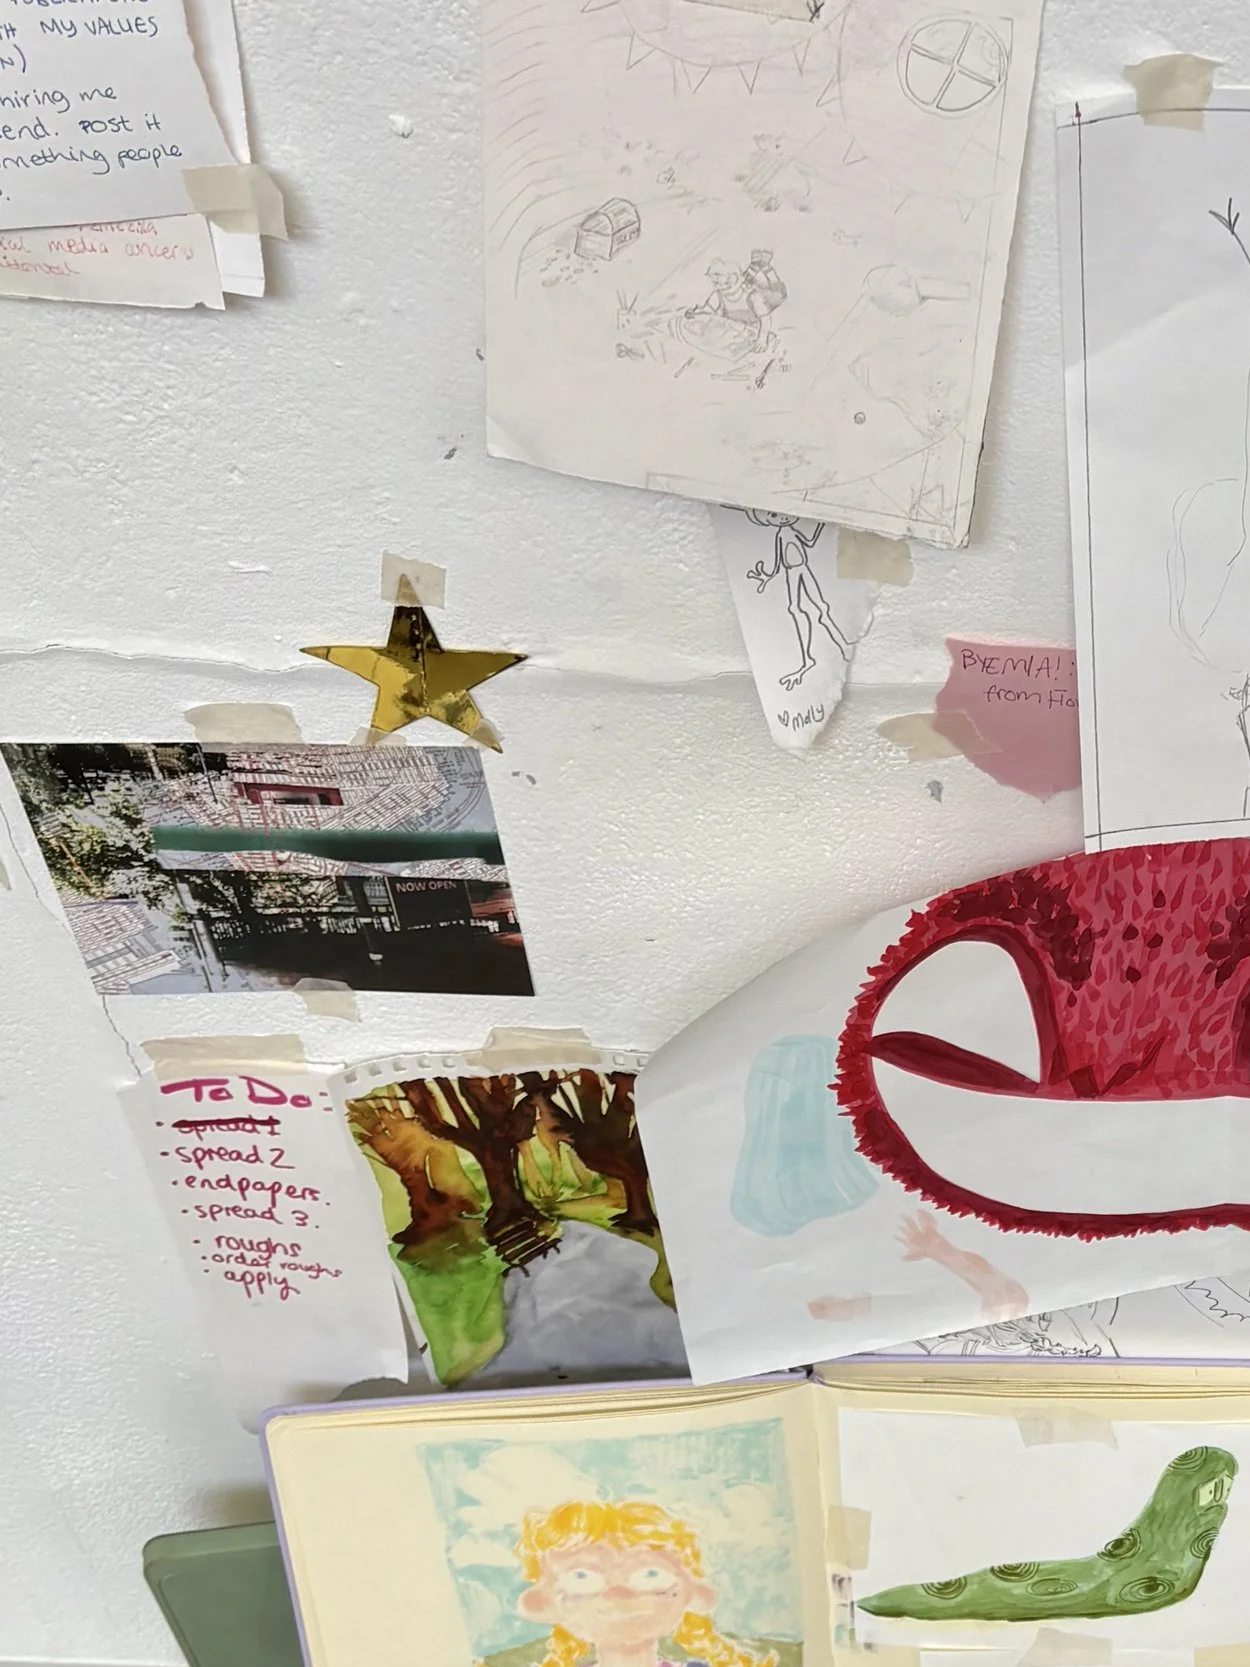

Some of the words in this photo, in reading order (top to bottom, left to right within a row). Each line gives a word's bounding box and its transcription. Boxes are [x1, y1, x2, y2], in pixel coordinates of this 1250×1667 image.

[84, 16, 158, 37] VALUES
[79, 86, 117, 101] me
[117, 144, 182, 169] people
[983, 684, 1042, 704] from
[395, 881, 426, 893] NOW
[428, 880, 457, 891] OPEN
[160, 1078, 234, 1102] To
[175, 1145, 264, 1170] spread
[269, 1148, 296, 1169] 2
[193, 1204, 283, 1224] spread
[215, 1235, 302, 1261] roughs
[211, 1253, 271, 1269] order
[224, 1270, 301, 1301] apply
